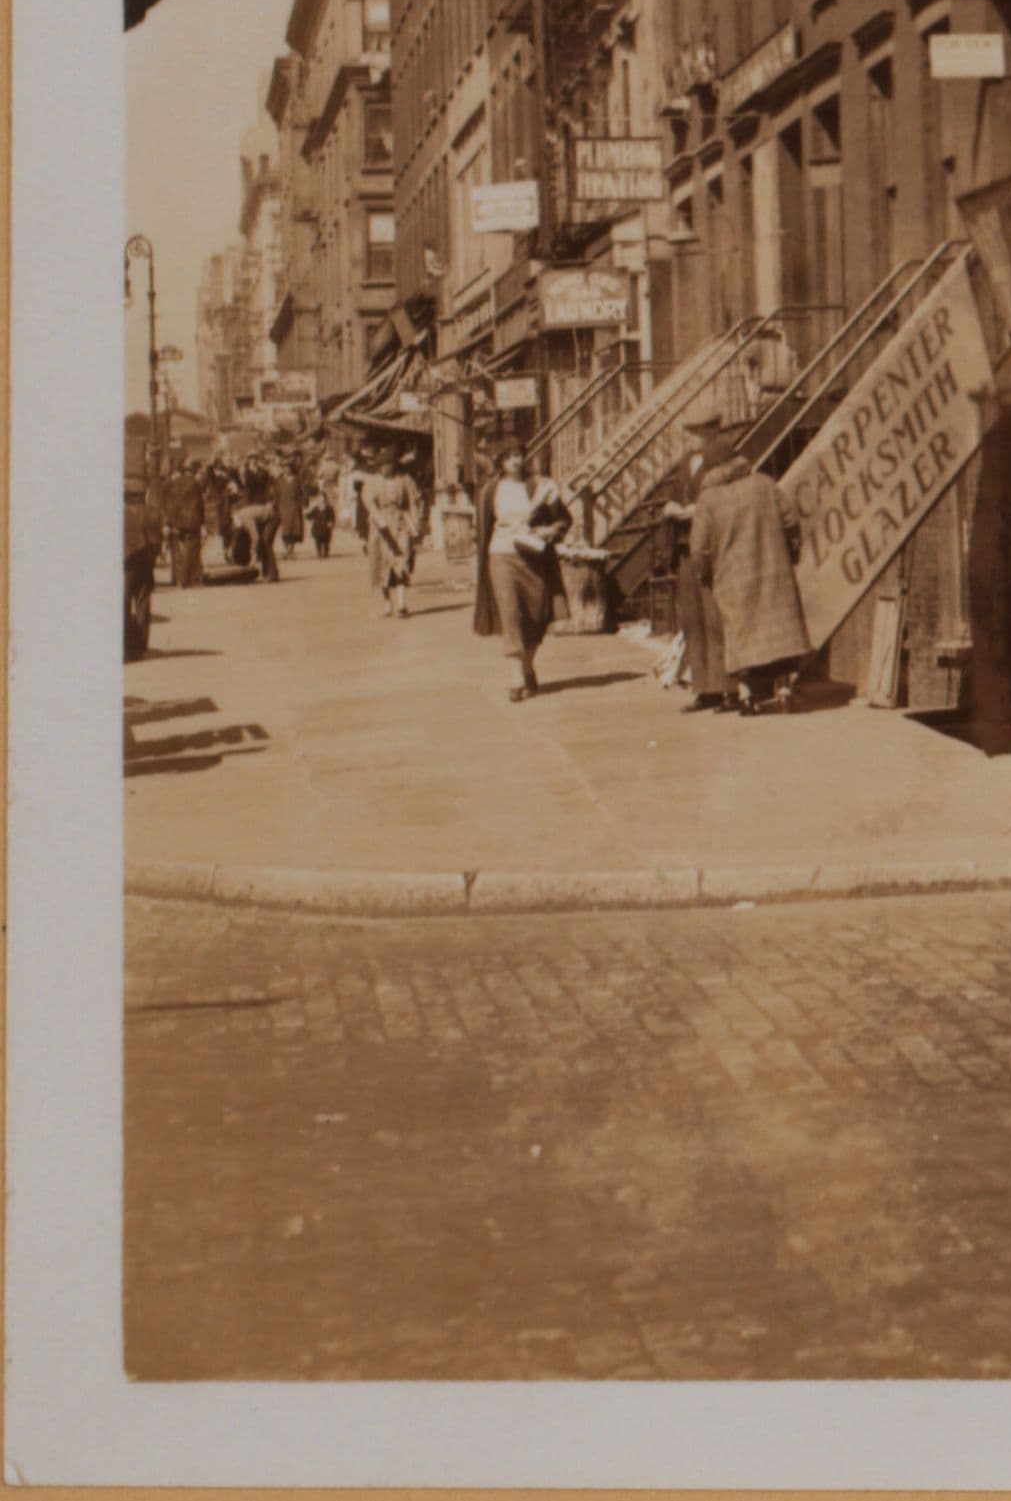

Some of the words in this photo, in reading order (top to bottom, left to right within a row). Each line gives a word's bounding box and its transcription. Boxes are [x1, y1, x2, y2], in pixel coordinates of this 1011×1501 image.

[794, 304, 956, 521] CARPENTER
[806, 360, 960, 570] LOCKSMITH
[840, 431, 957, 587] GLAZER
